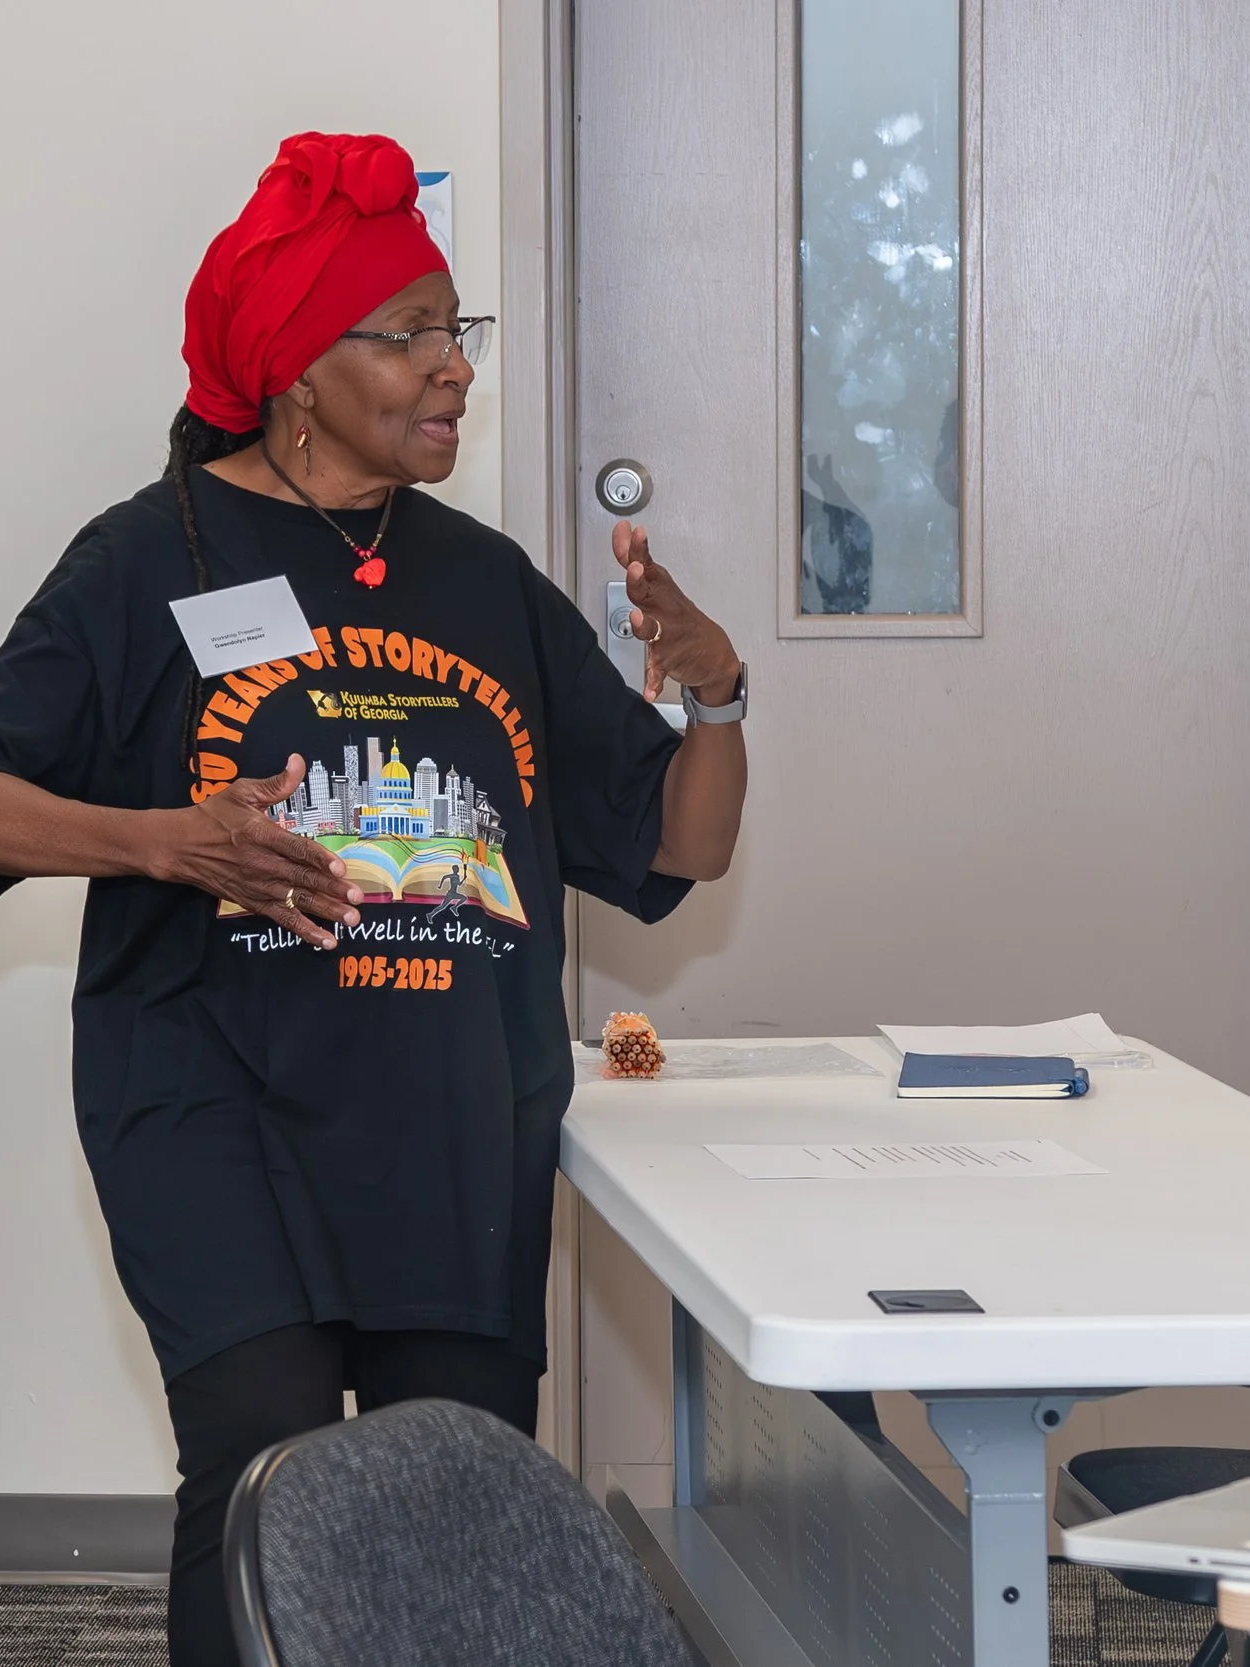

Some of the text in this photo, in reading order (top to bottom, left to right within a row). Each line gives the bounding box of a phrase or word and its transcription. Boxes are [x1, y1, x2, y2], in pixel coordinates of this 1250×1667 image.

[348, 918, 405, 941] Well
[410, 916, 438, 942] in
[443, 920, 483, 945] the
[339, 955, 453, 991] 1995-2025
